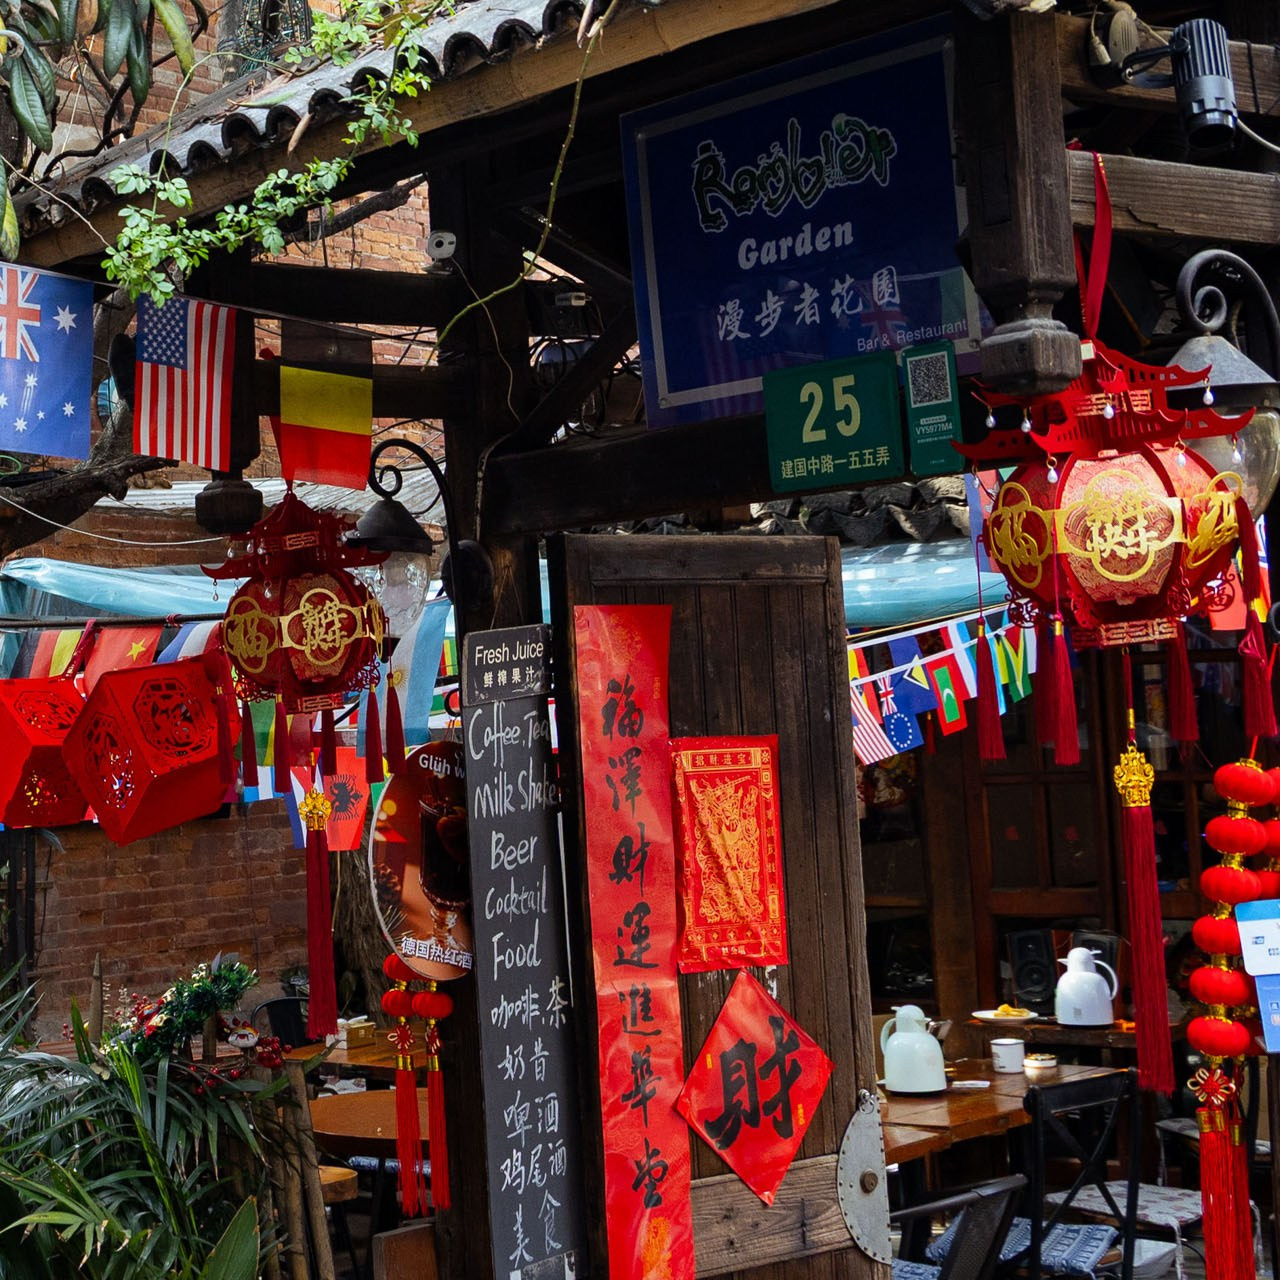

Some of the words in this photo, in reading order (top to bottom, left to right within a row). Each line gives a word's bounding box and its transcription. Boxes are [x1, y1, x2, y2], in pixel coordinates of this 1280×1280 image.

[691, 112, 898, 234] Rambler
[737, 221, 854, 270] Garden
[857, 335, 881, 352] Bar
[881, 333, 891, 348] &
[895, 318, 968, 345] Restaurant
[800, 374, 861, 443] 25
[781, 446, 891, 479] 建国中路一五五弄
[475, 642, 510, 666] Fresh
[512, 640, 544, 661] Juice
[483, 666, 535, 688] 鲜榨果汁
[419, 753, 450, 775] Glüh
[475, 771, 516, 819] Milk
[518, 756, 558, 812] Shake
[491, 830, 538, 870] Beer
[485, 865, 548, 923] Cocktail
[401, 936, 473, 970] 德国热红酒
[491, 918, 541, 981] Food
[497, 1037, 550, 1082] 奶昔
[503, 1090, 560, 1147] 啤酒
[499, 1139, 568, 1195] 鸡尾酒
[509, 1189, 563, 1268] 美食
